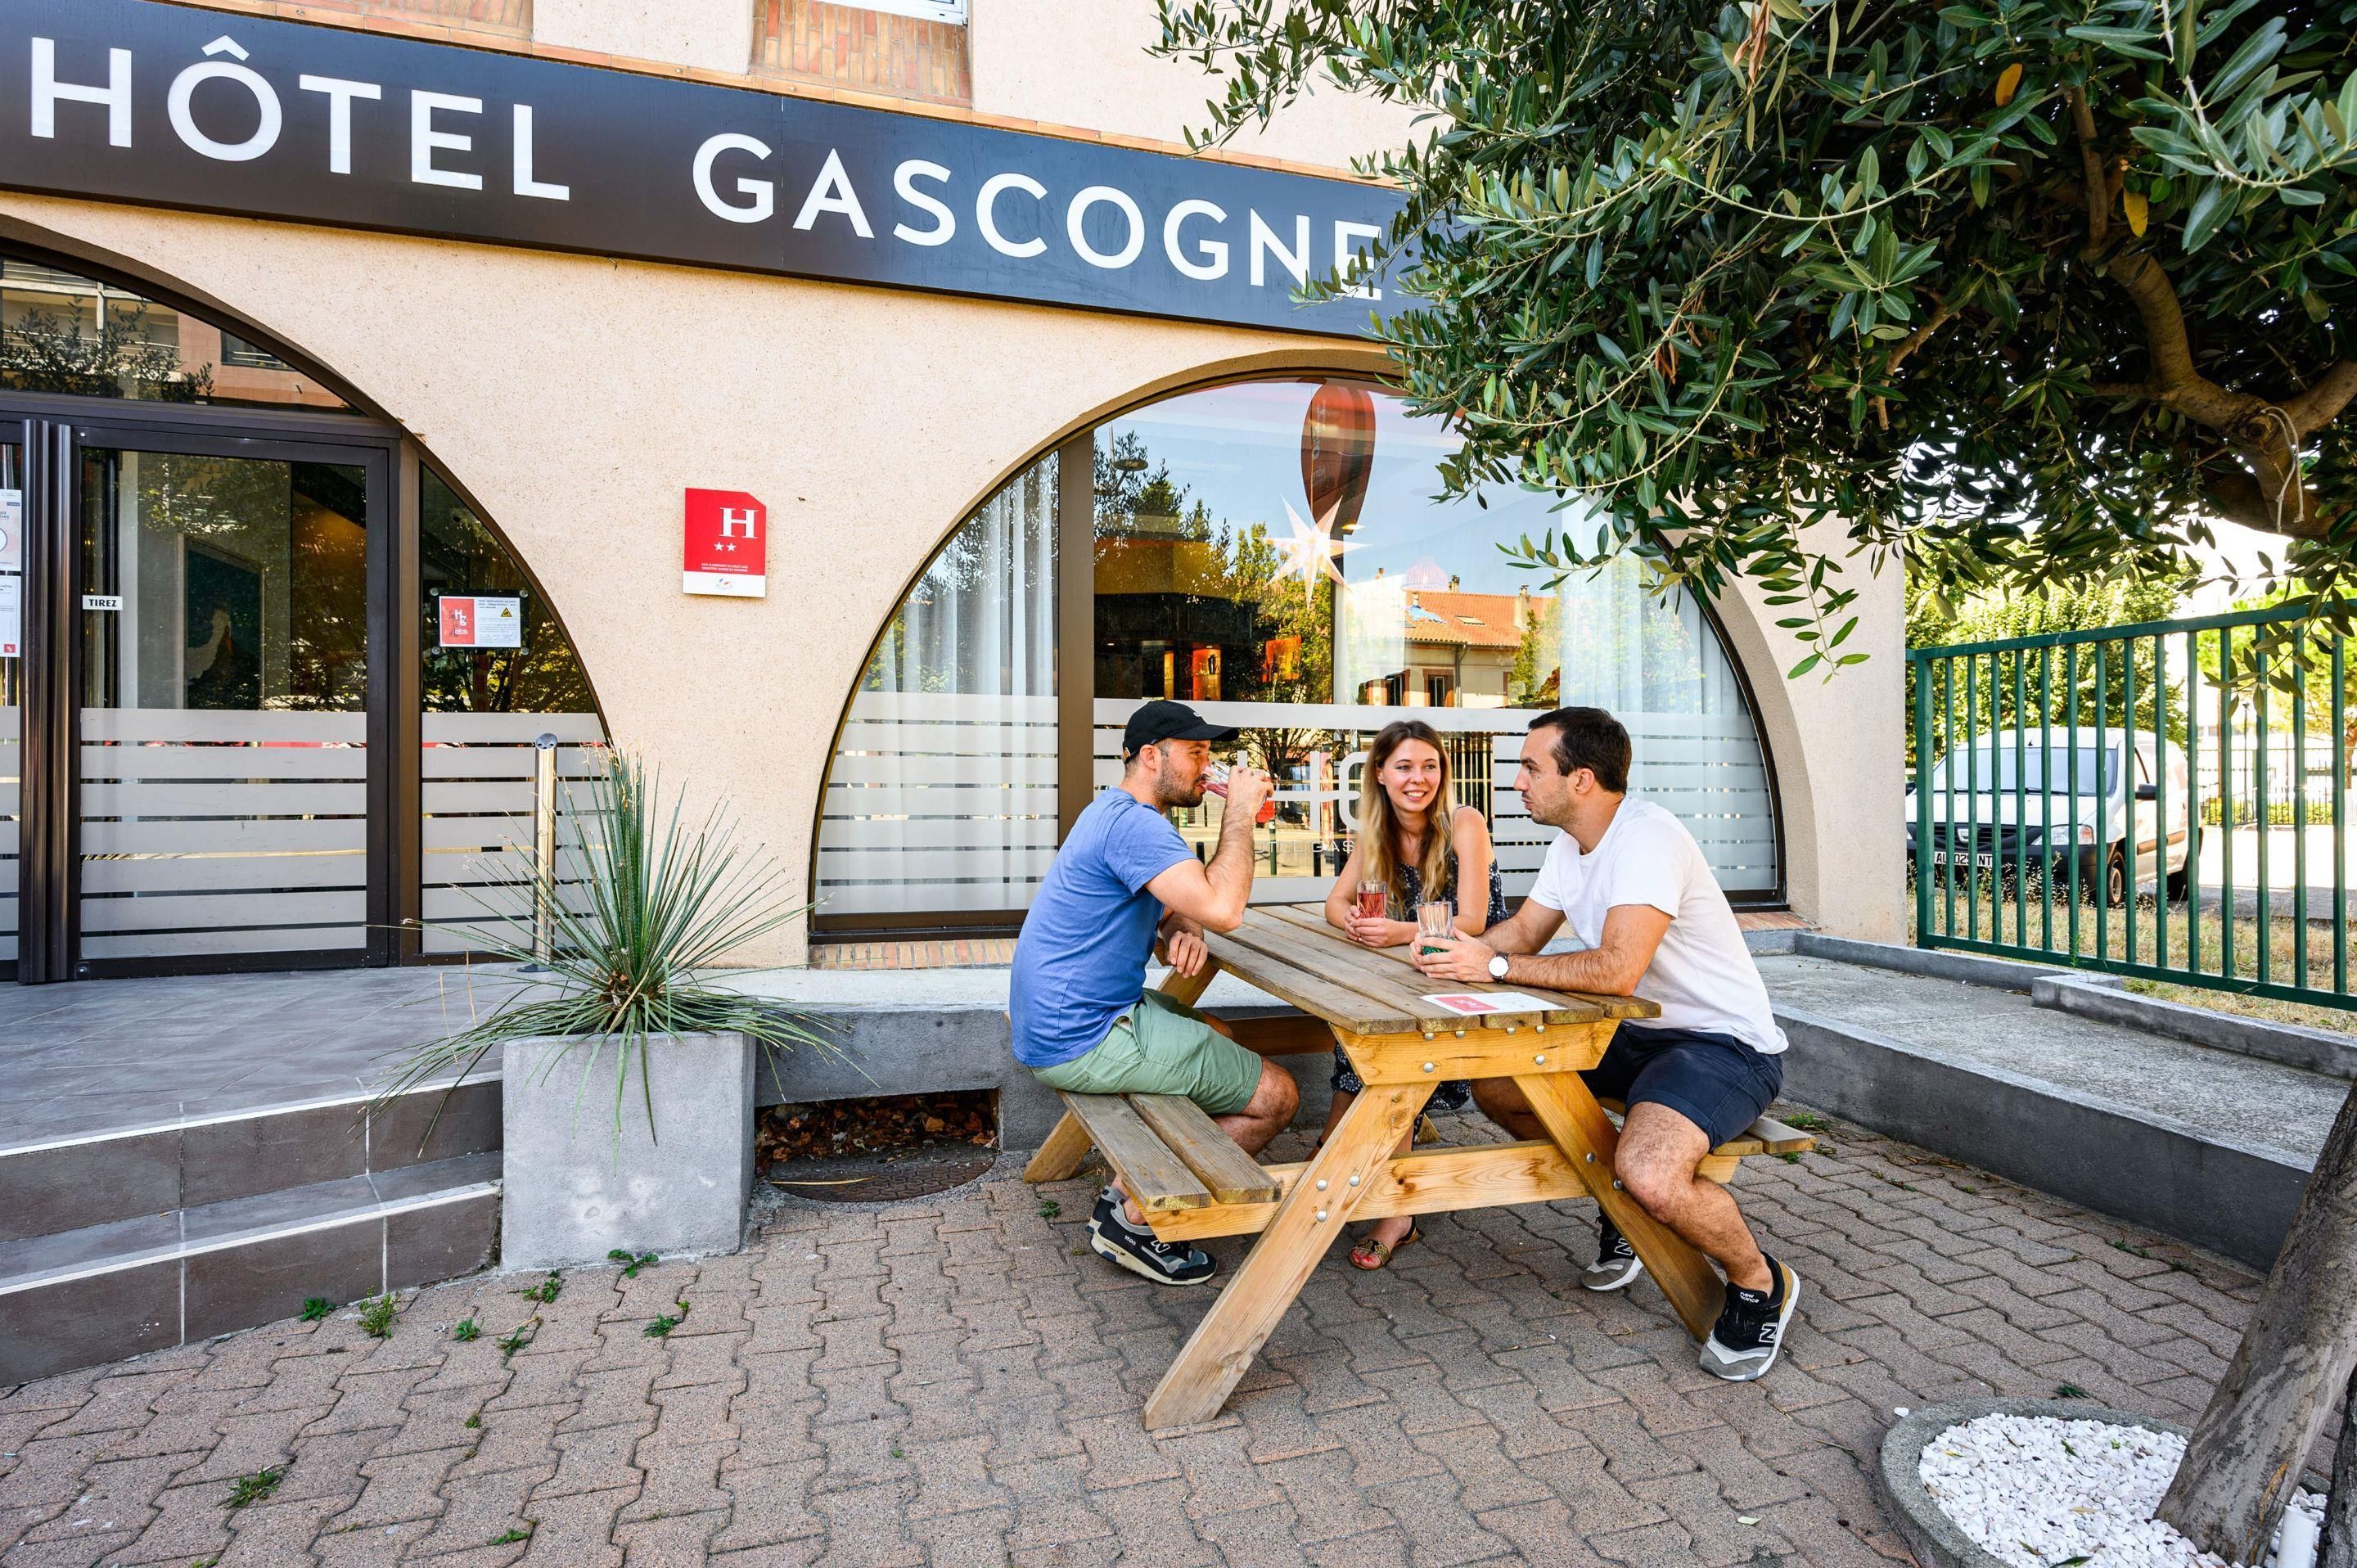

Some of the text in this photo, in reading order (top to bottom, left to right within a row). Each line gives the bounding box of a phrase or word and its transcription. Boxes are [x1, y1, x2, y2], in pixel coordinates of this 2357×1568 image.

[30, 34, 1382, 301] HÔTEL GASCOGNE
[719, 507, 759, 539] H
[88, 598, 118, 607] TIREZ
